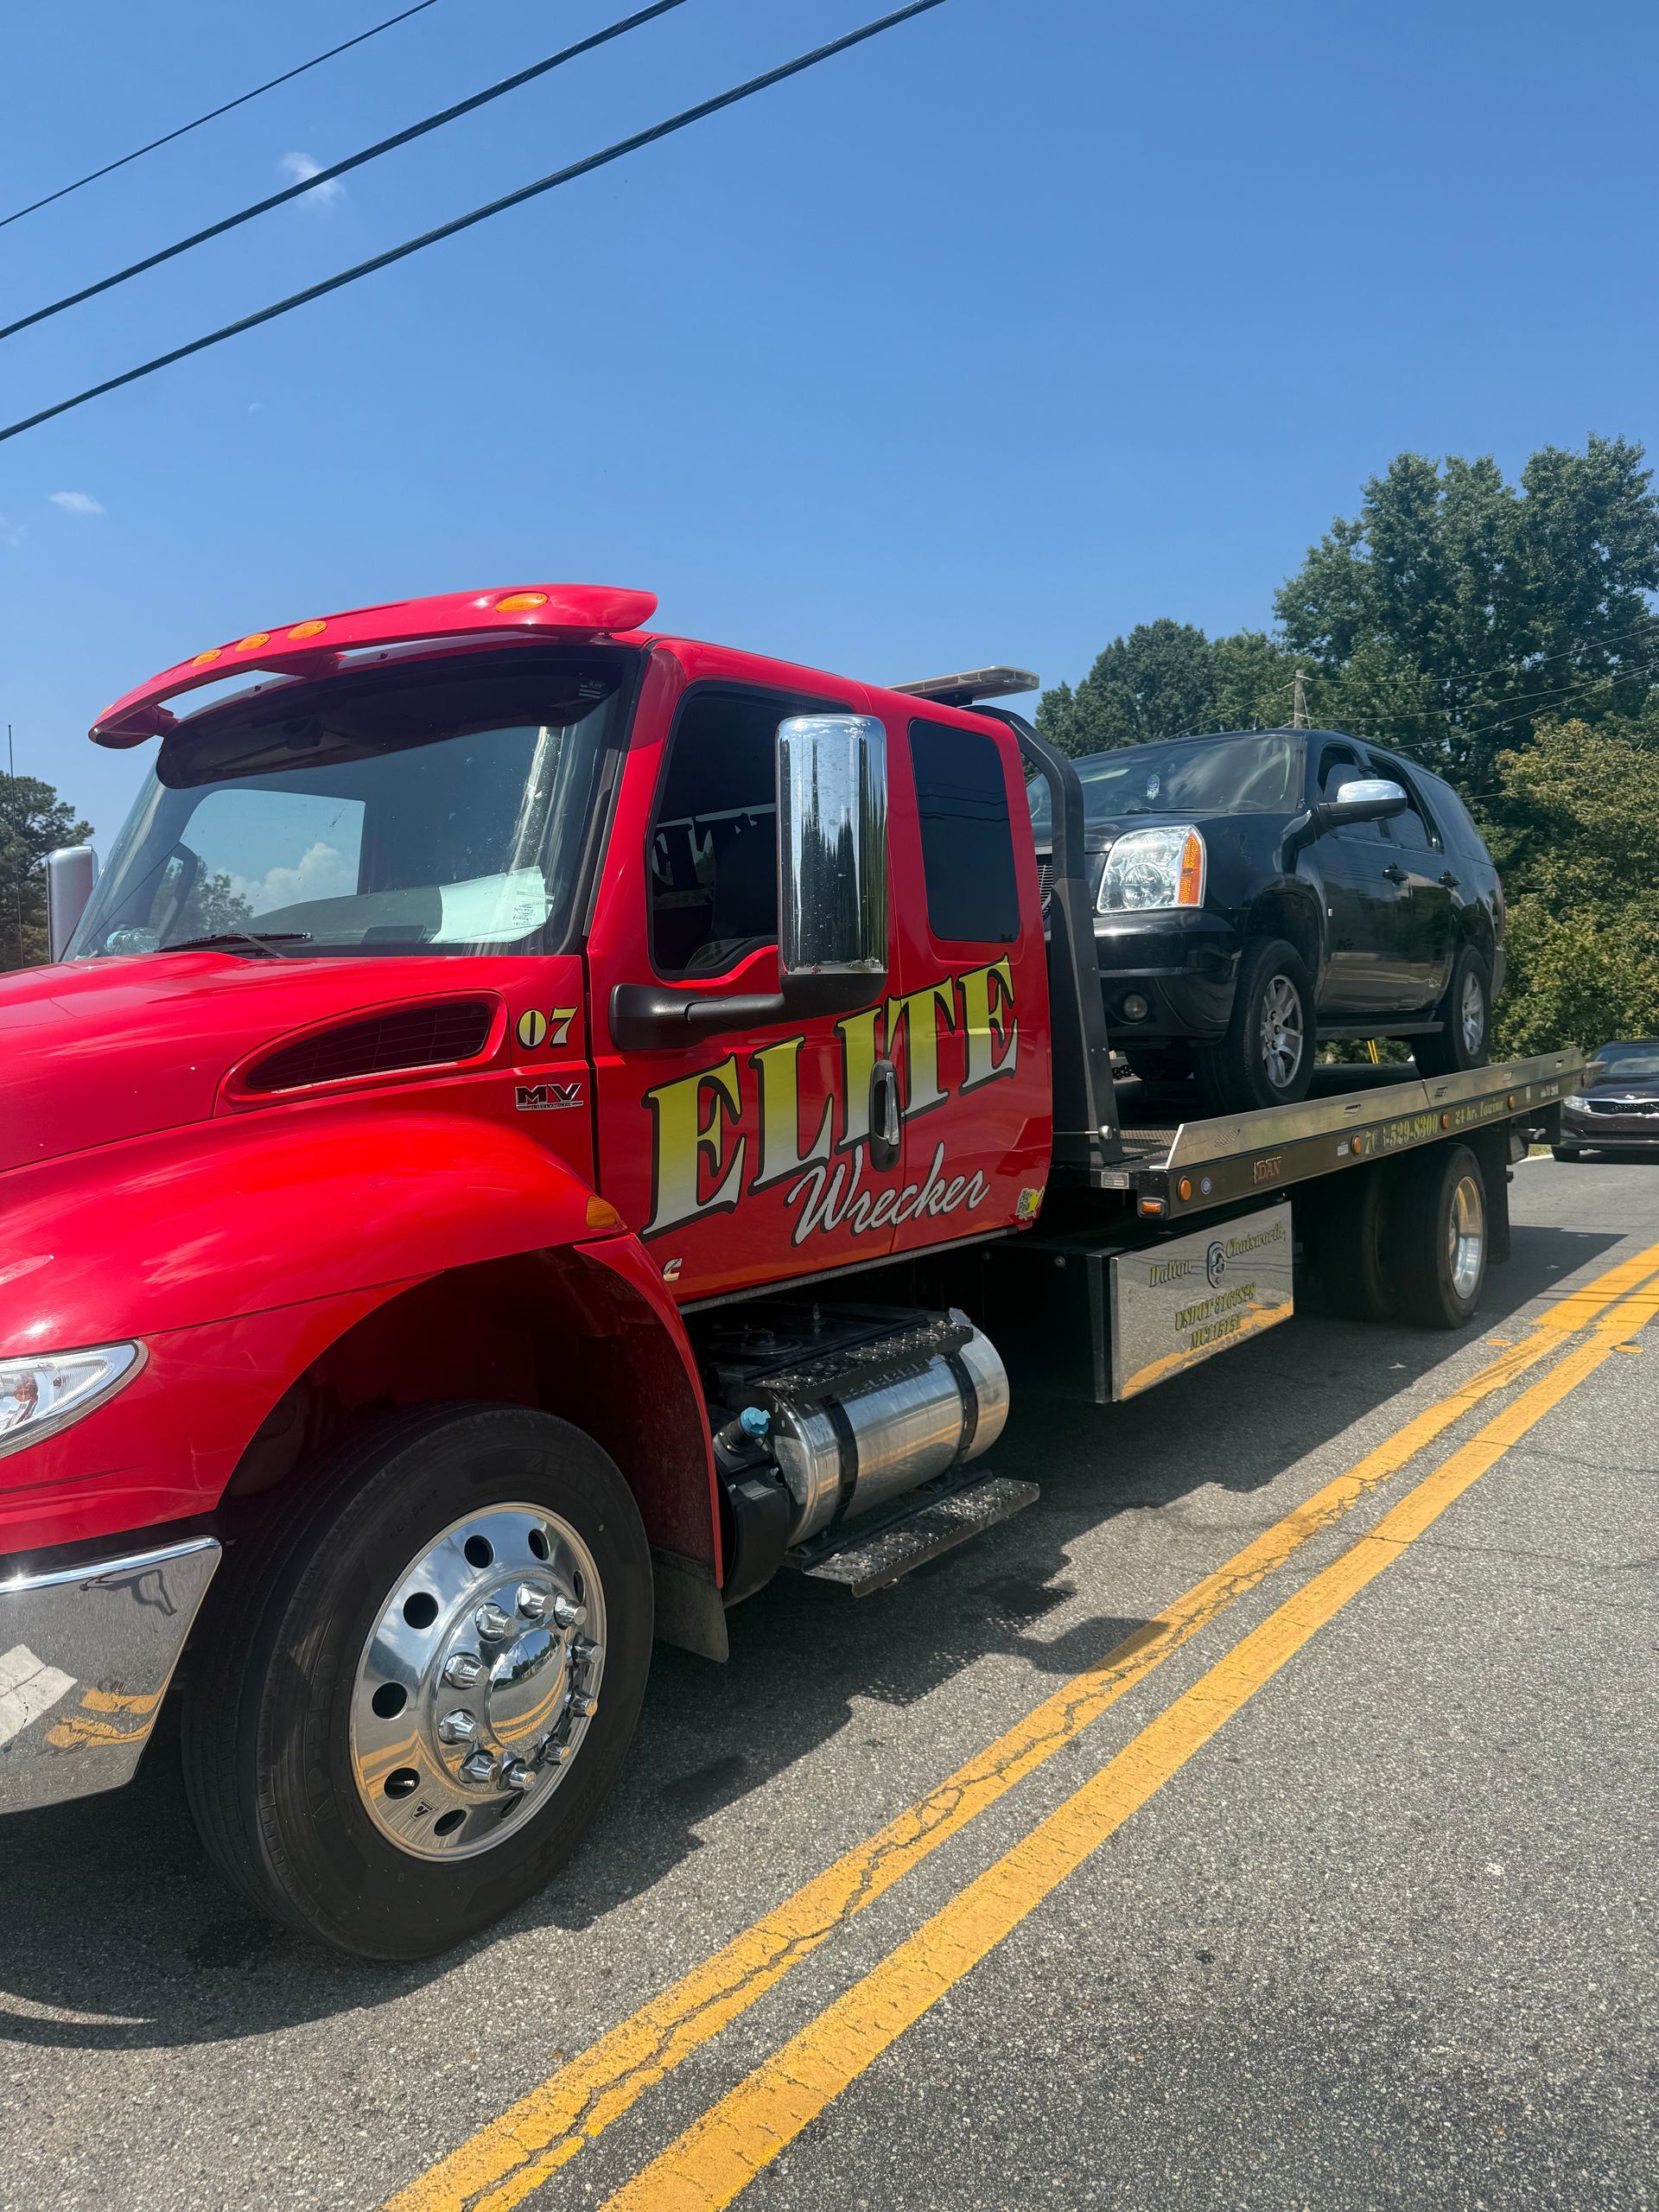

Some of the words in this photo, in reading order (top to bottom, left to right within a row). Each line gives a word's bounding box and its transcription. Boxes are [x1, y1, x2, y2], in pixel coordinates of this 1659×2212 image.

[515, 1005, 578, 1049] 07
[515, 1082, 582, 1104] MV
[641, 951, 1019, 1243] ELITE
[1455, 1108, 1465, 1125] 24
[785, 1141, 991, 1248] Wrecker
[1149, 1259, 1192, 1287] Dalton
[1175, 1297, 1213, 1331] USDOT
